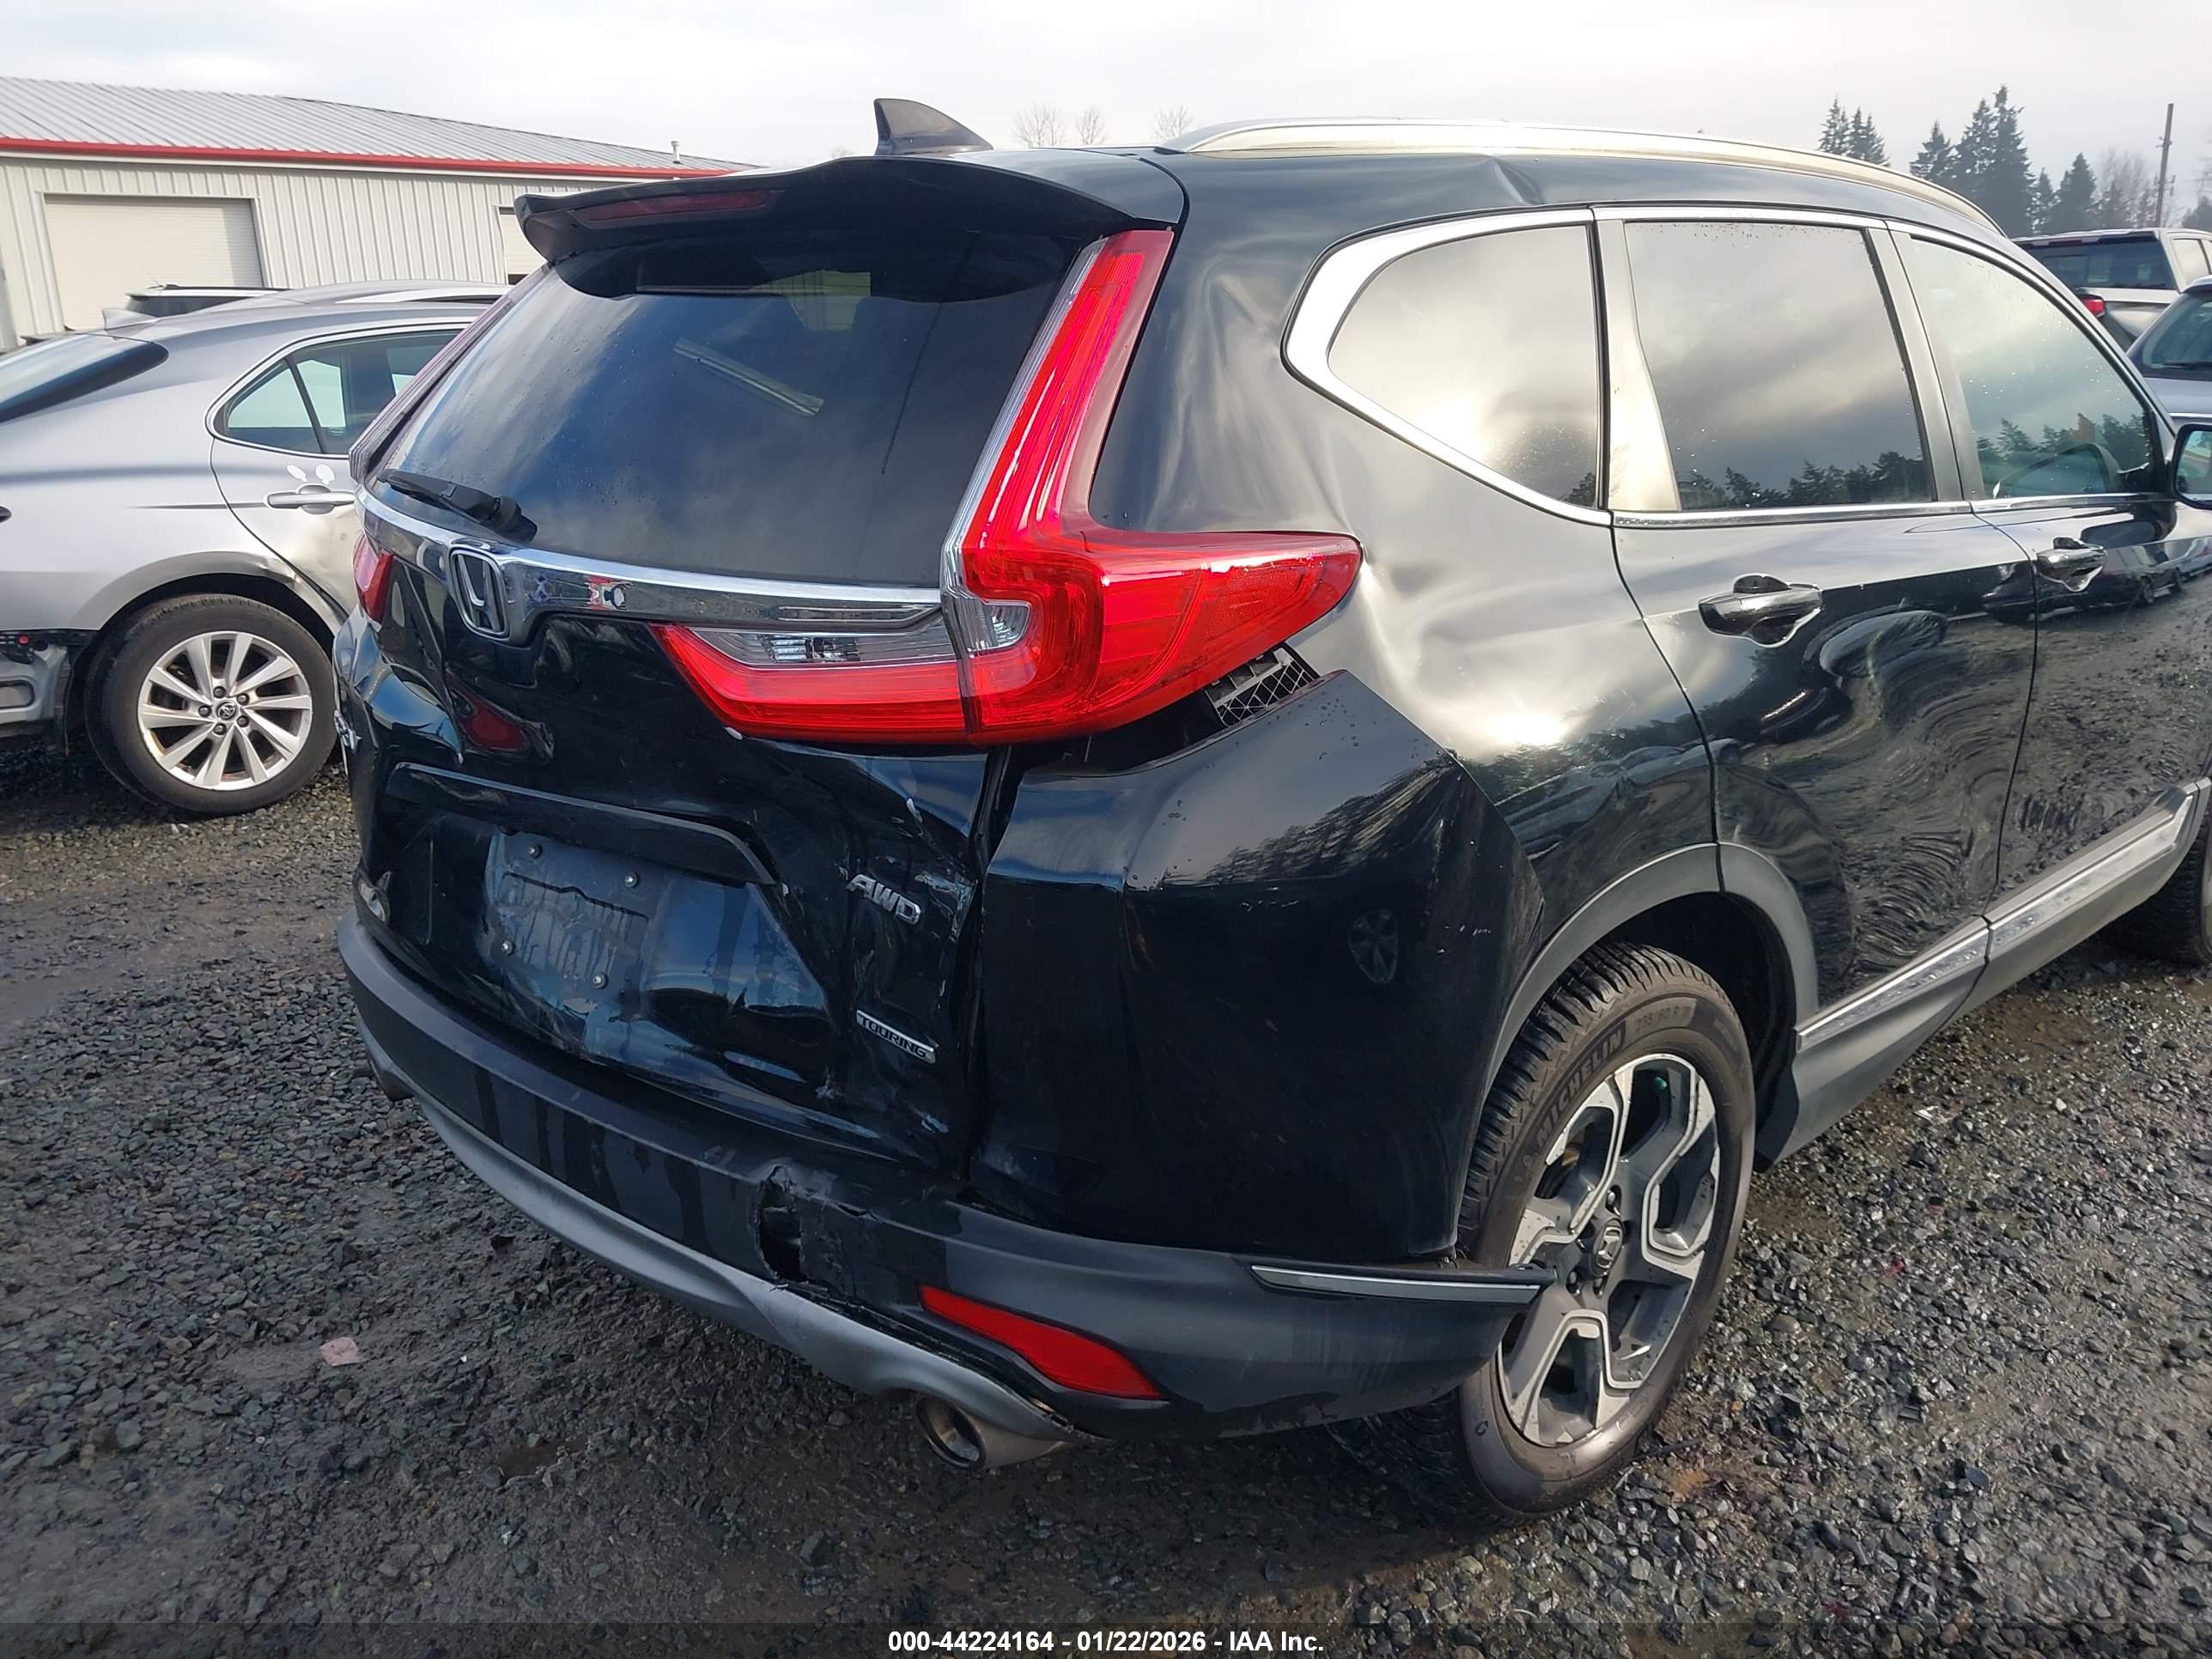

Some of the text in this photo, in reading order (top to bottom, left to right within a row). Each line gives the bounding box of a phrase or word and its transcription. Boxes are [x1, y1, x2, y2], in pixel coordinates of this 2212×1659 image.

[846, 873, 922, 925] AWD
[860, 1016, 928, 1059] TOURING
[1536, 1029, 1624, 1148] MICHELIN
